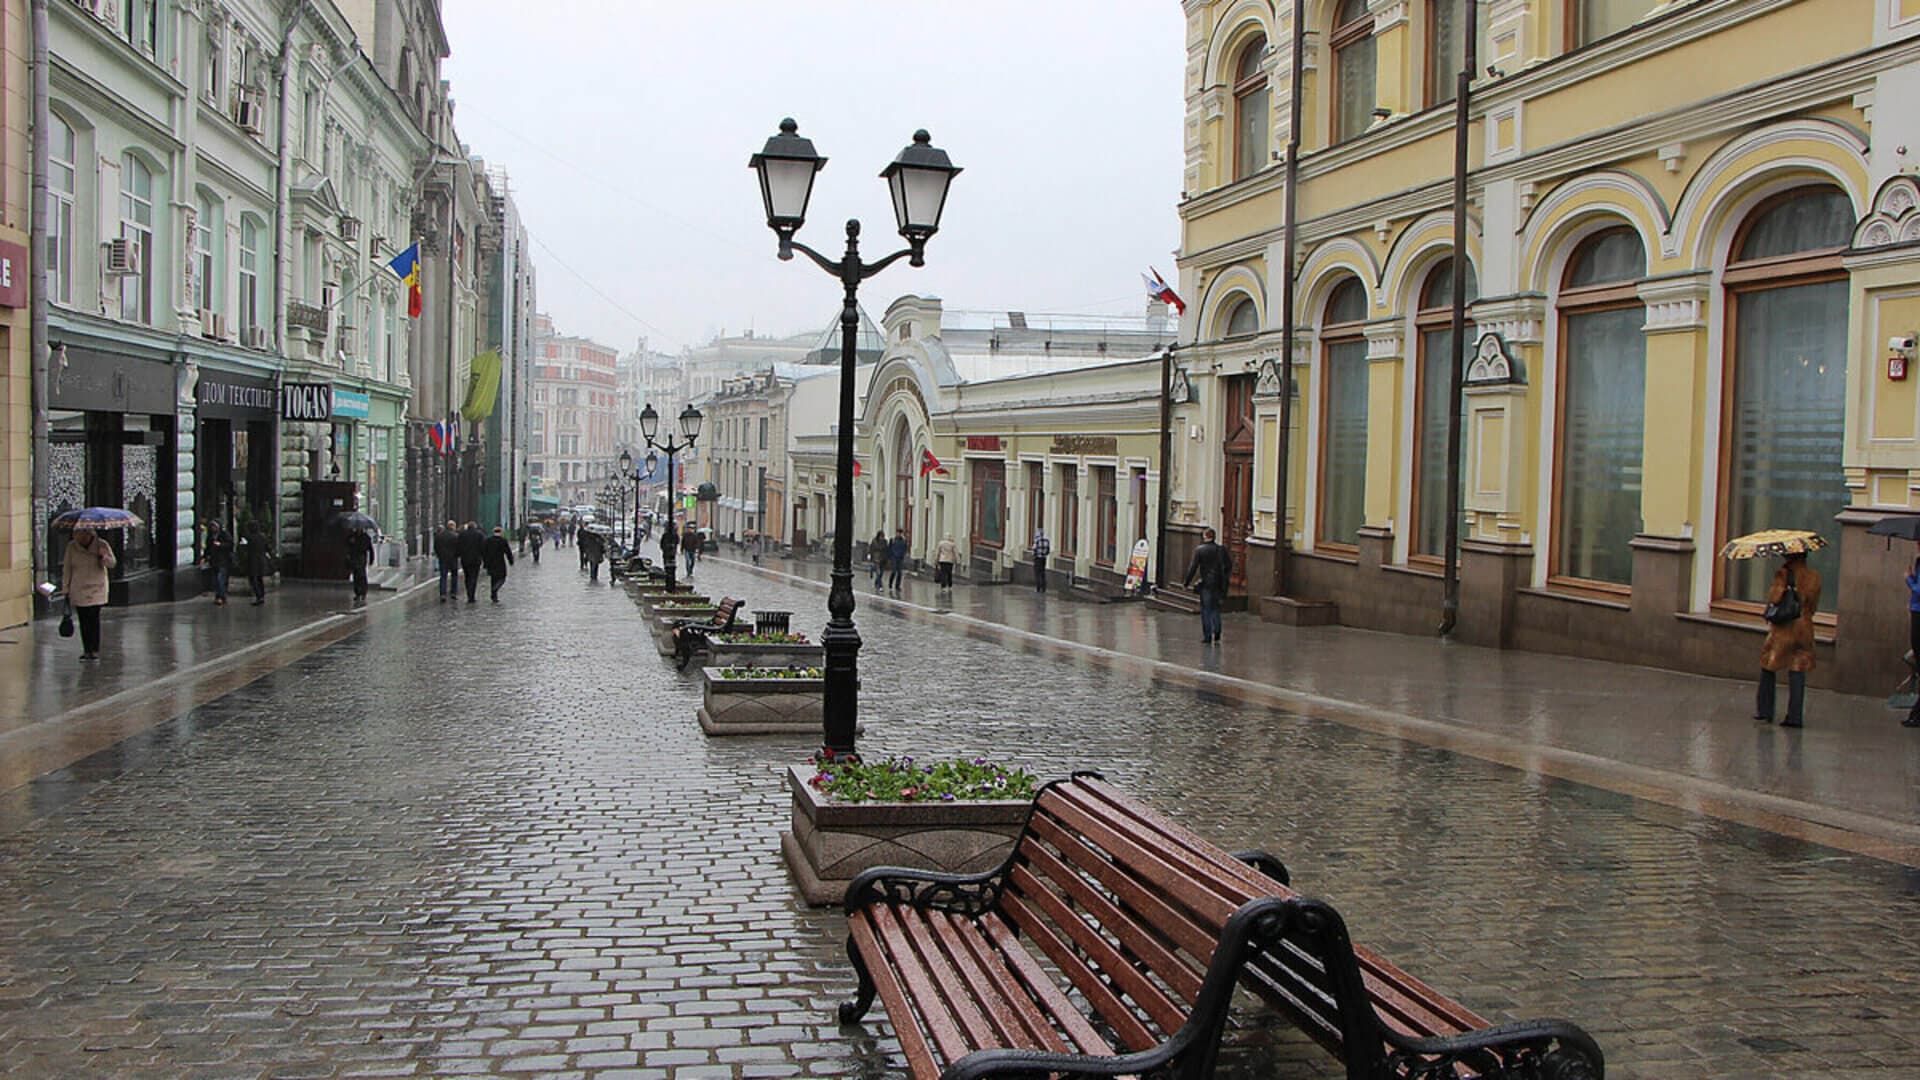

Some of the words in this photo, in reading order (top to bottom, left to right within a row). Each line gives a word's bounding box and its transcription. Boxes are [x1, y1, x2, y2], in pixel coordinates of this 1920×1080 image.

[0, 257, 11, 288] E
[202, 382, 225, 405] ДОМ
[229, 385, 271, 408] ТЕКСТИЛЯ
[284, 385, 328, 418] TOGAS
